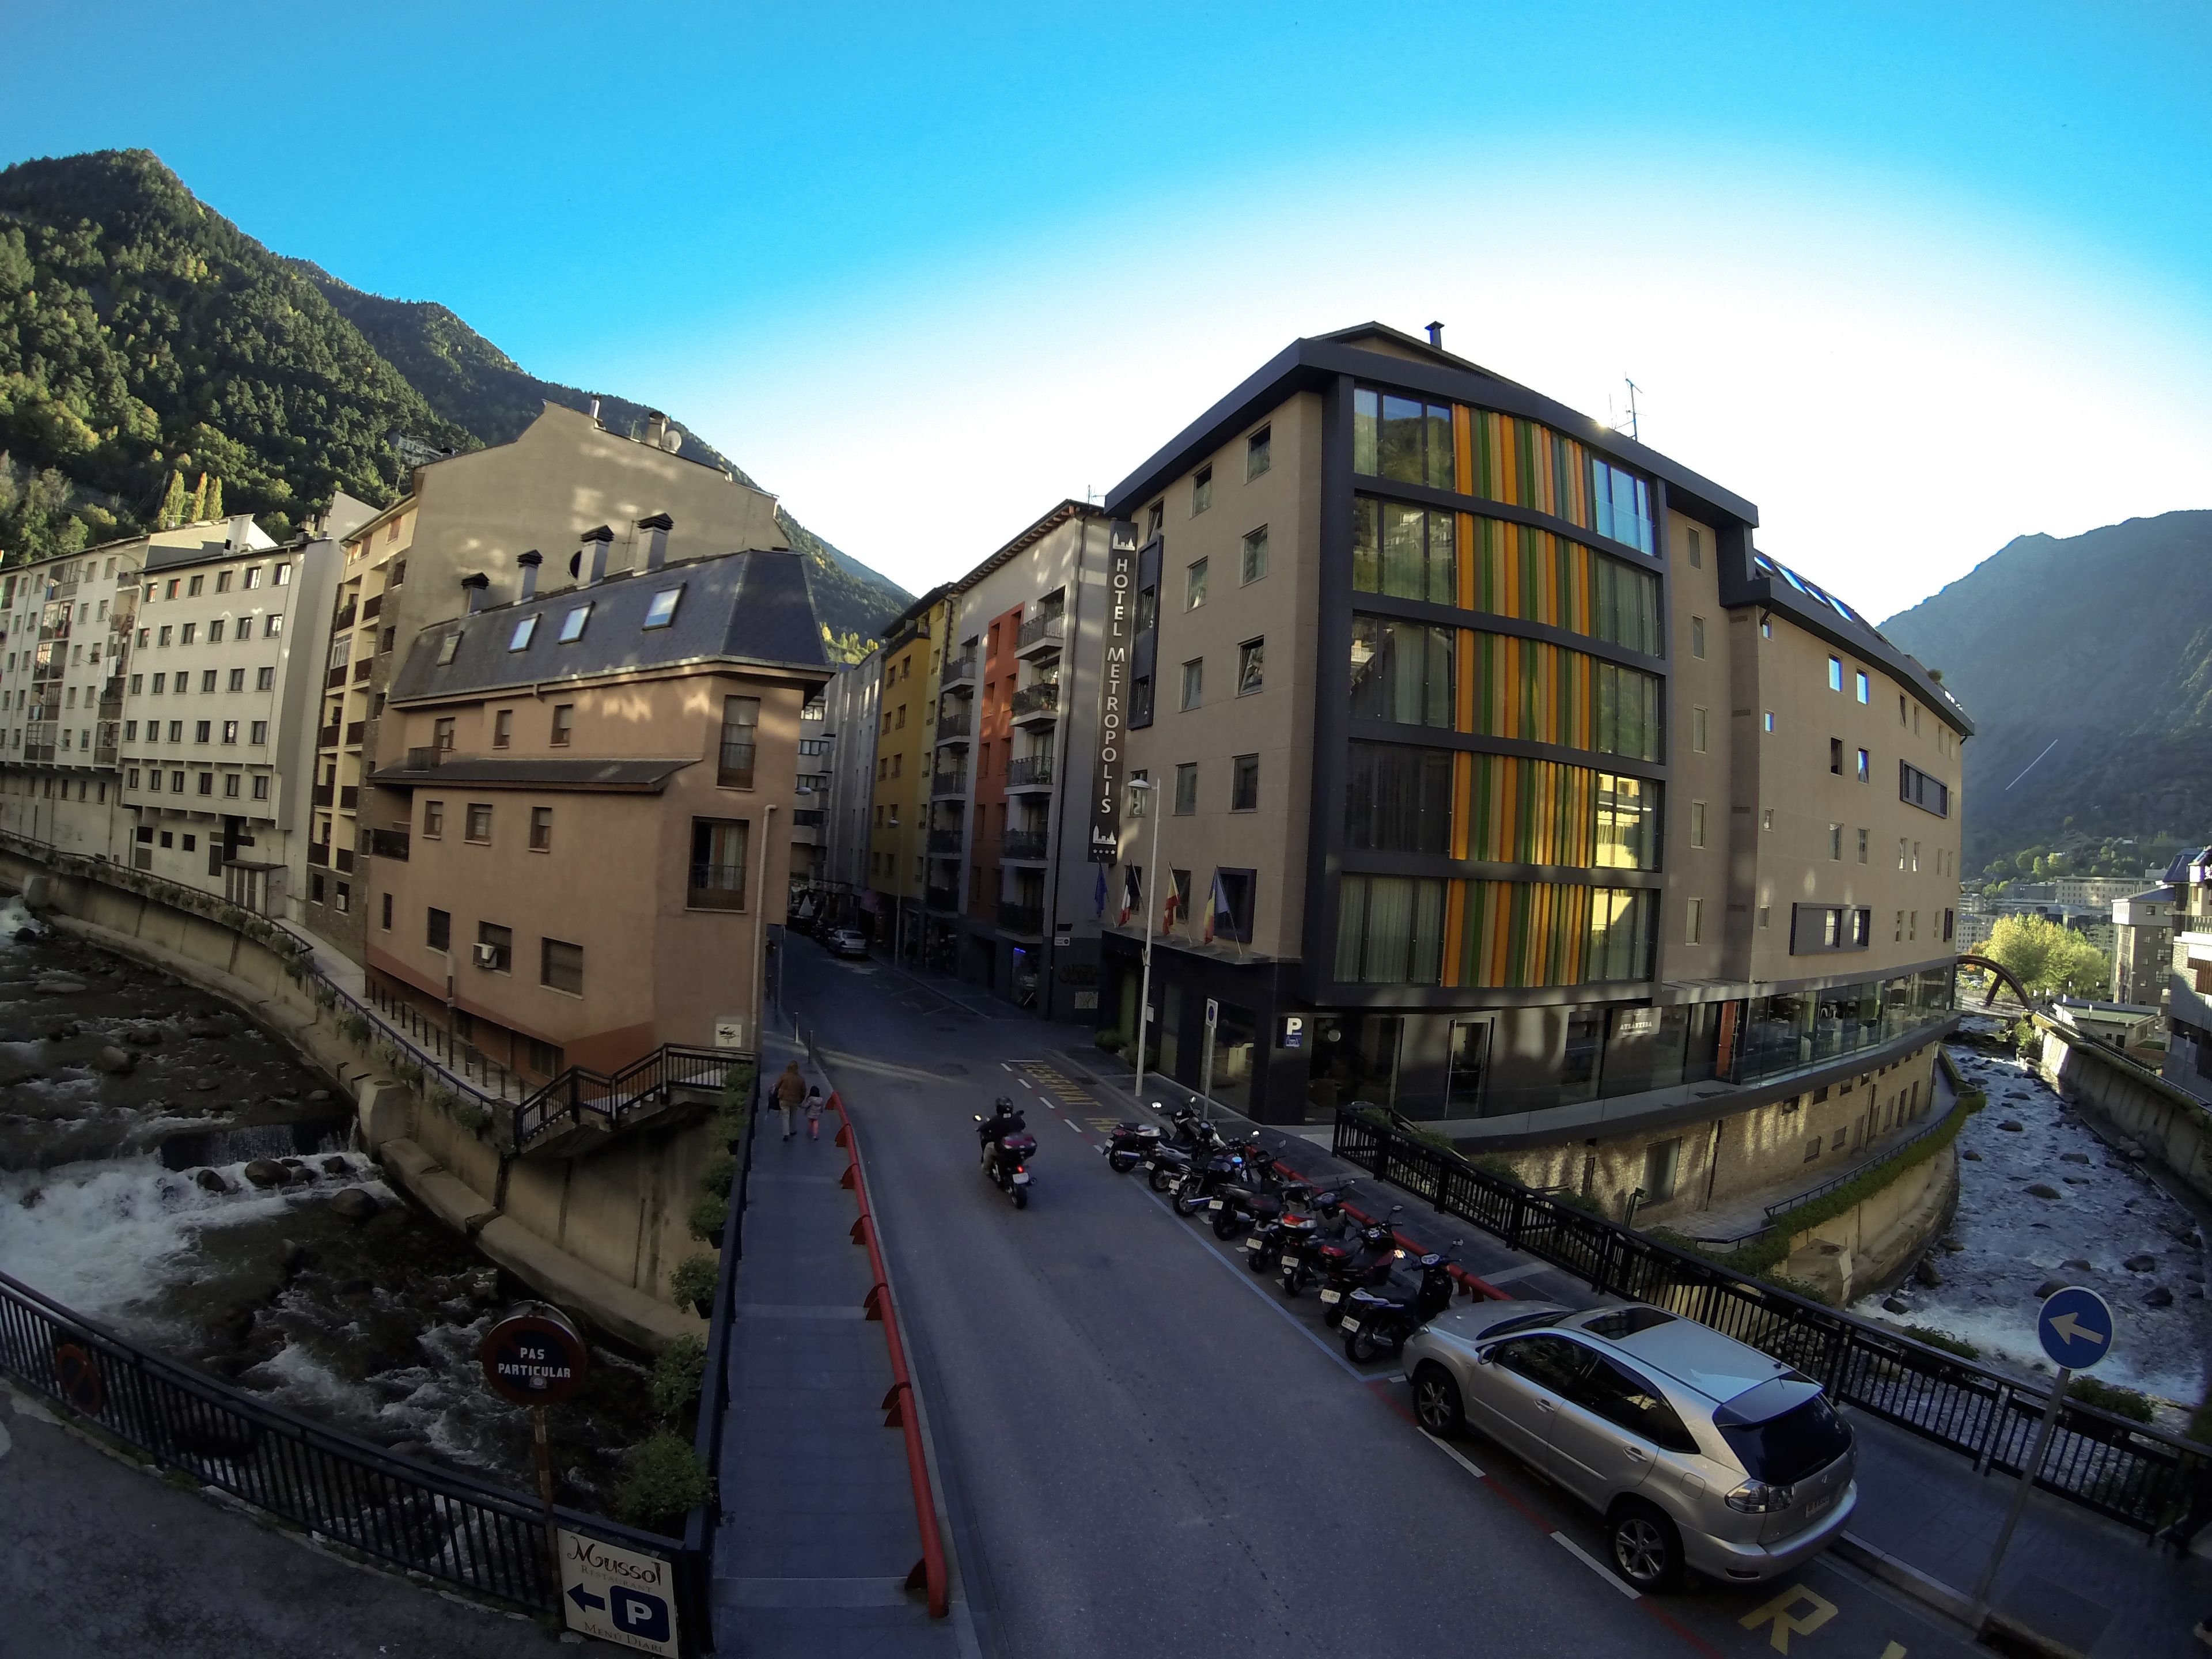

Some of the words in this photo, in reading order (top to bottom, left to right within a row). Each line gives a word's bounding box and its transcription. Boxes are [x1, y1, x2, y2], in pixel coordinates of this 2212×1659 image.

[1112, 558, 1128, 637] HOTEL
[1100, 647, 1125, 814] METROPOLIS
[1286, 1017, 1302, 1035] P
[520, 1347, 545, 1360] PAS
[498, 1363, 571, 1378] PARTICULAR
[567, 1535, 661, 1586] Mussol
[626, 1599, 653, 1625] P
